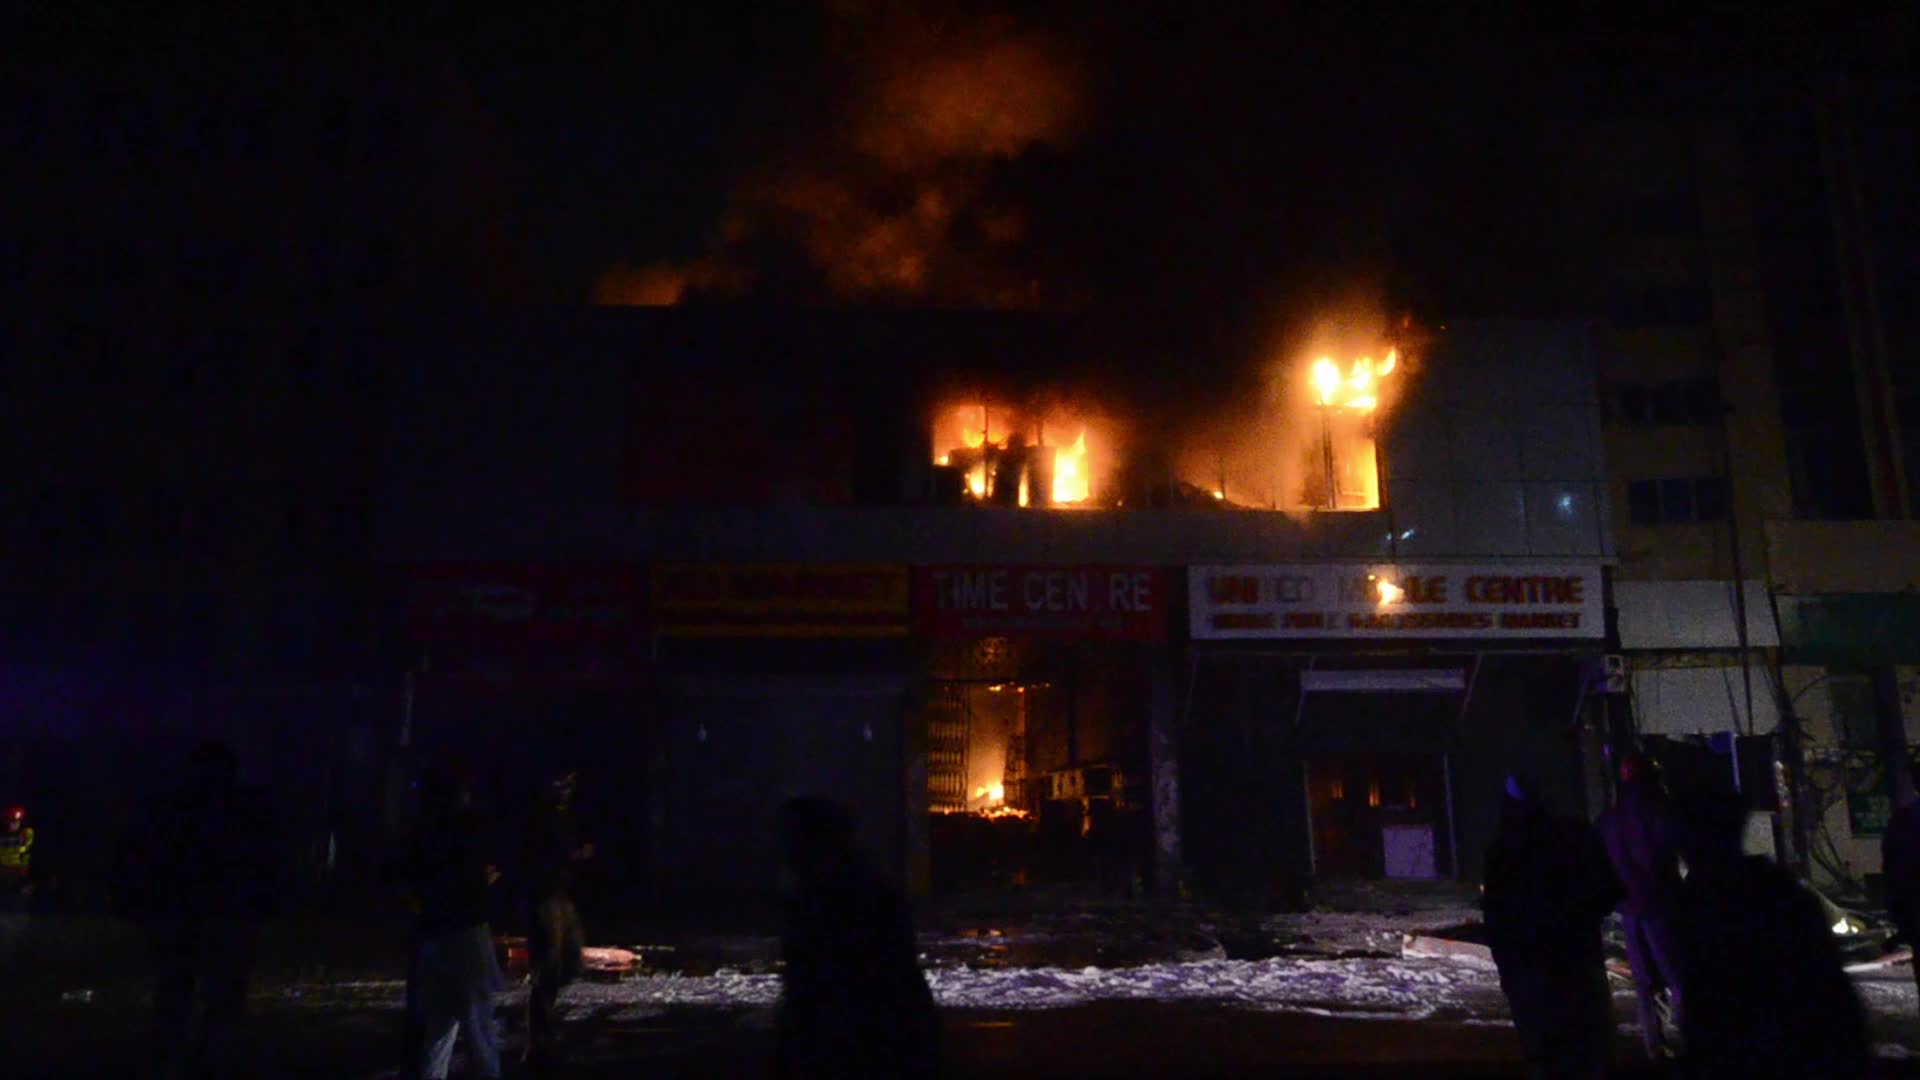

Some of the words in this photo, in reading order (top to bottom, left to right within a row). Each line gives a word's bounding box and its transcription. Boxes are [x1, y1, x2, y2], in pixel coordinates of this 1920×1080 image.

[932, 570, 1008, 610] TIME
[1024, 570, 1152, 612] CENRE
[1466, 575, 1585, 603] CENTRE
